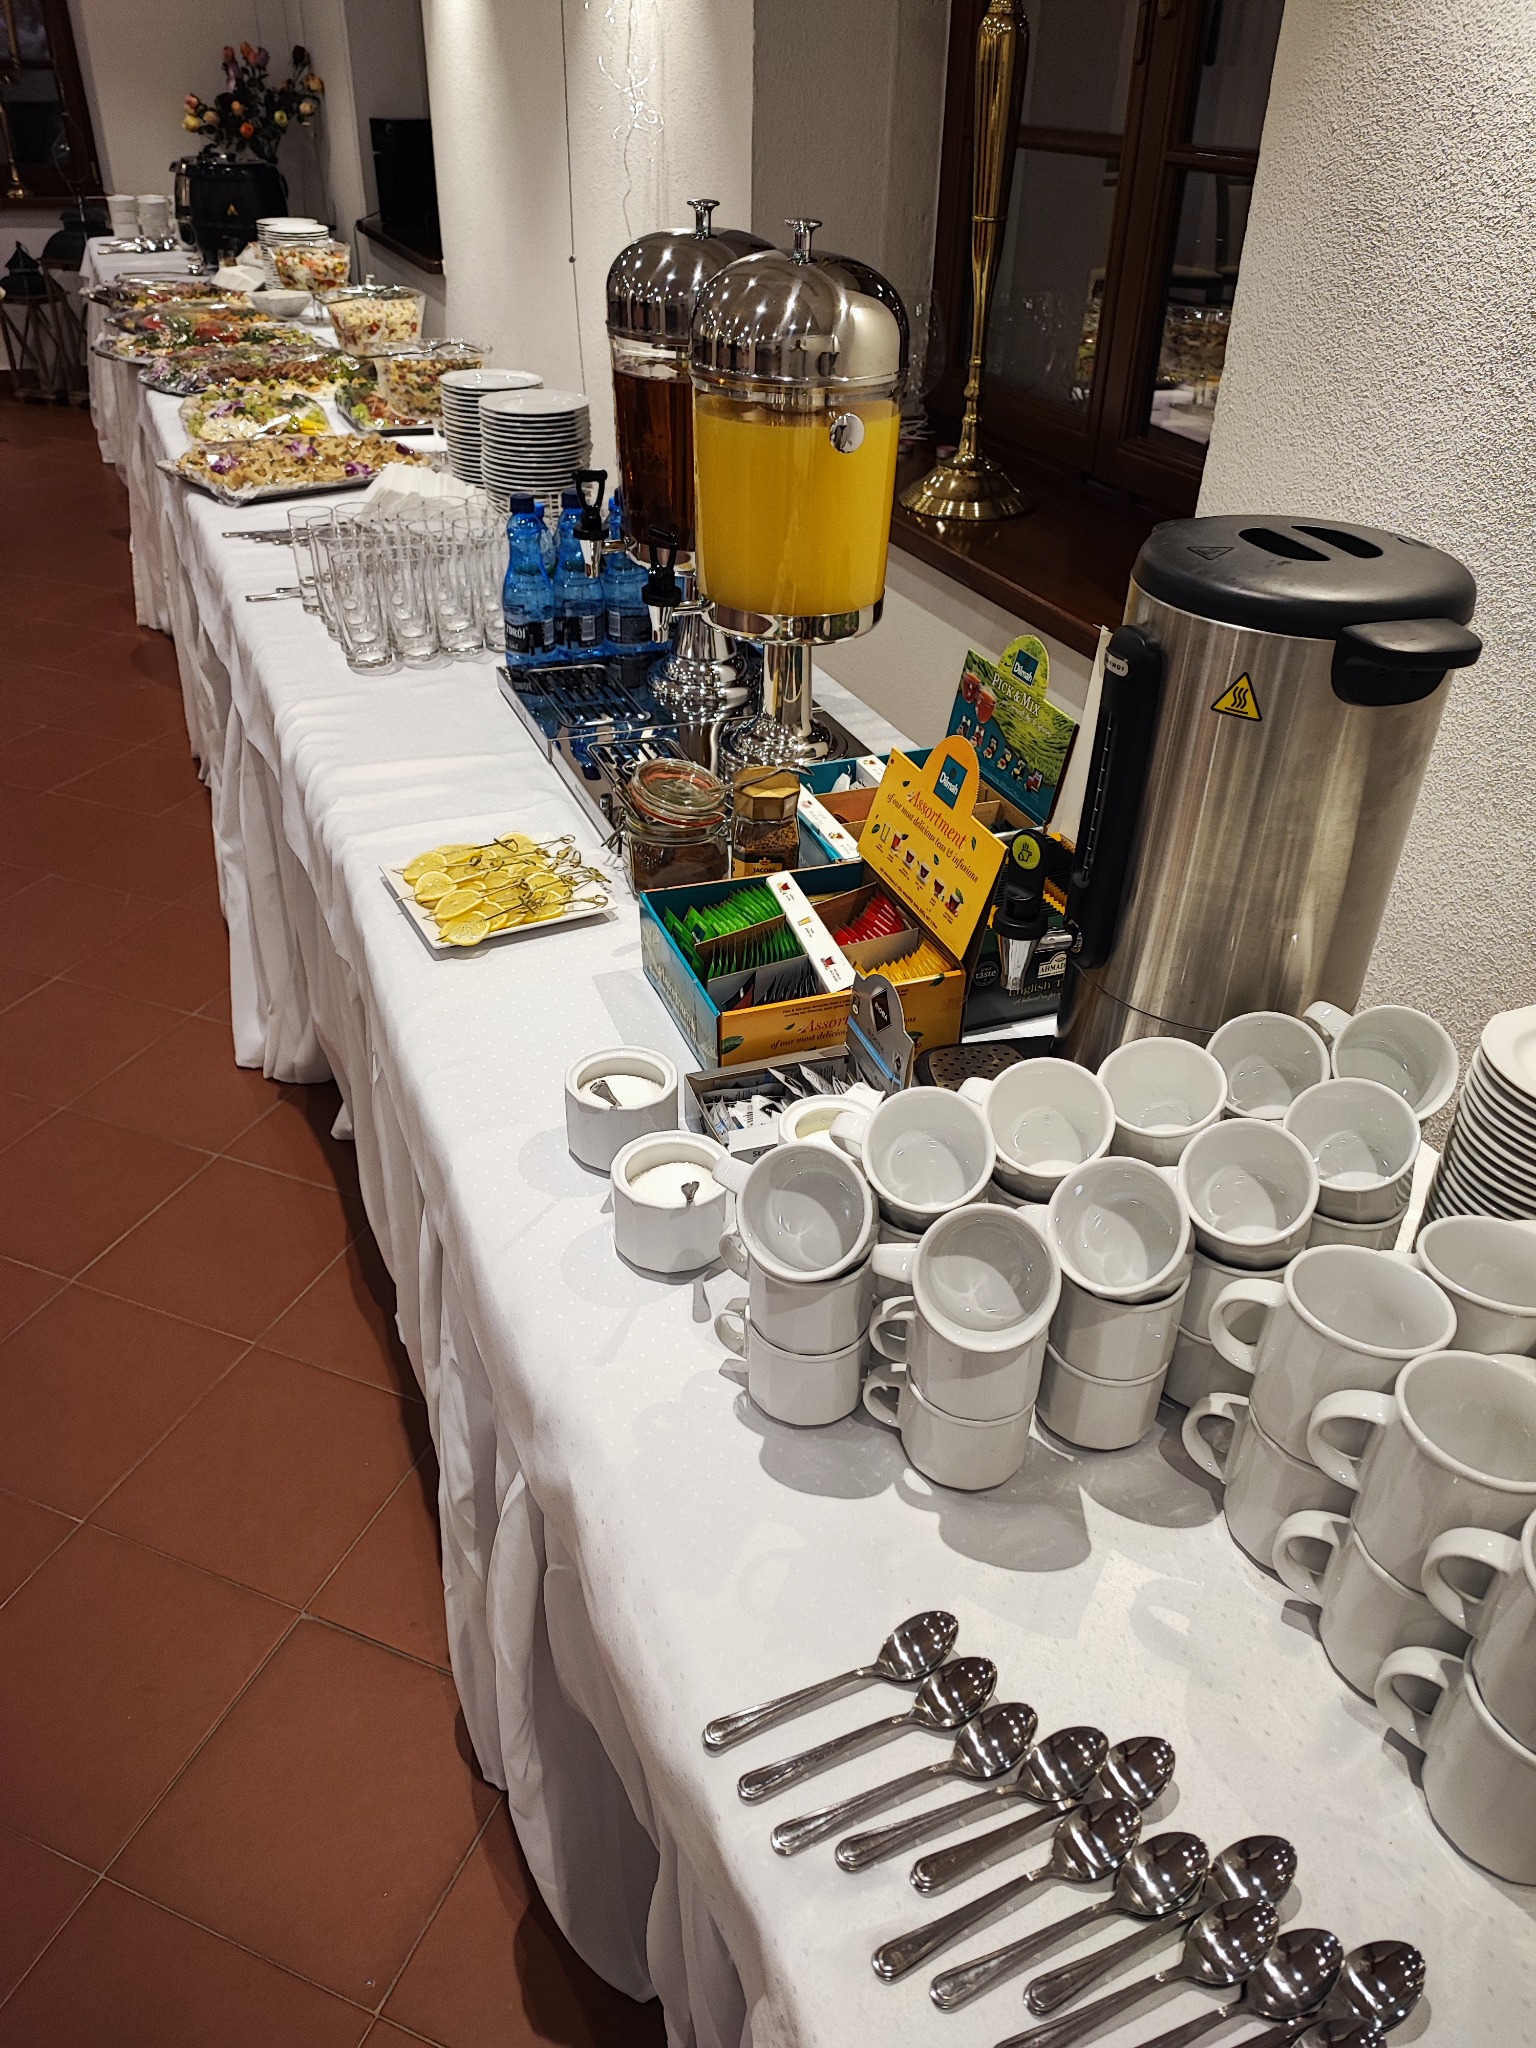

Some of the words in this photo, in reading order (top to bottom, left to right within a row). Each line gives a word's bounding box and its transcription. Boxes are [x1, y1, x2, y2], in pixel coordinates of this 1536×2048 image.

[1013, 661, 1034, 683] Dilmah
[992, 672, 1013, 698] PICK
[1020, 692, 1042, 717] MIX
[939, 771, 959, 796] Dilmah
[908, 790, 967, 849] Assortment
[901, 806, 914, 820] most
[913, 816, 936, 843] delicious
[934, 837, 947, 853] teas
[951, 853, 979, 884] infusions
[975, 969, 997, 980] taste
[1008, 982, 1052, 997] English
[797, 1016, 850, 1034] Assort
[770, 1040, 779, 1050] of
[796, 1034, 816, 1044] most
[816, 1028, 848, 1041] deliciou
